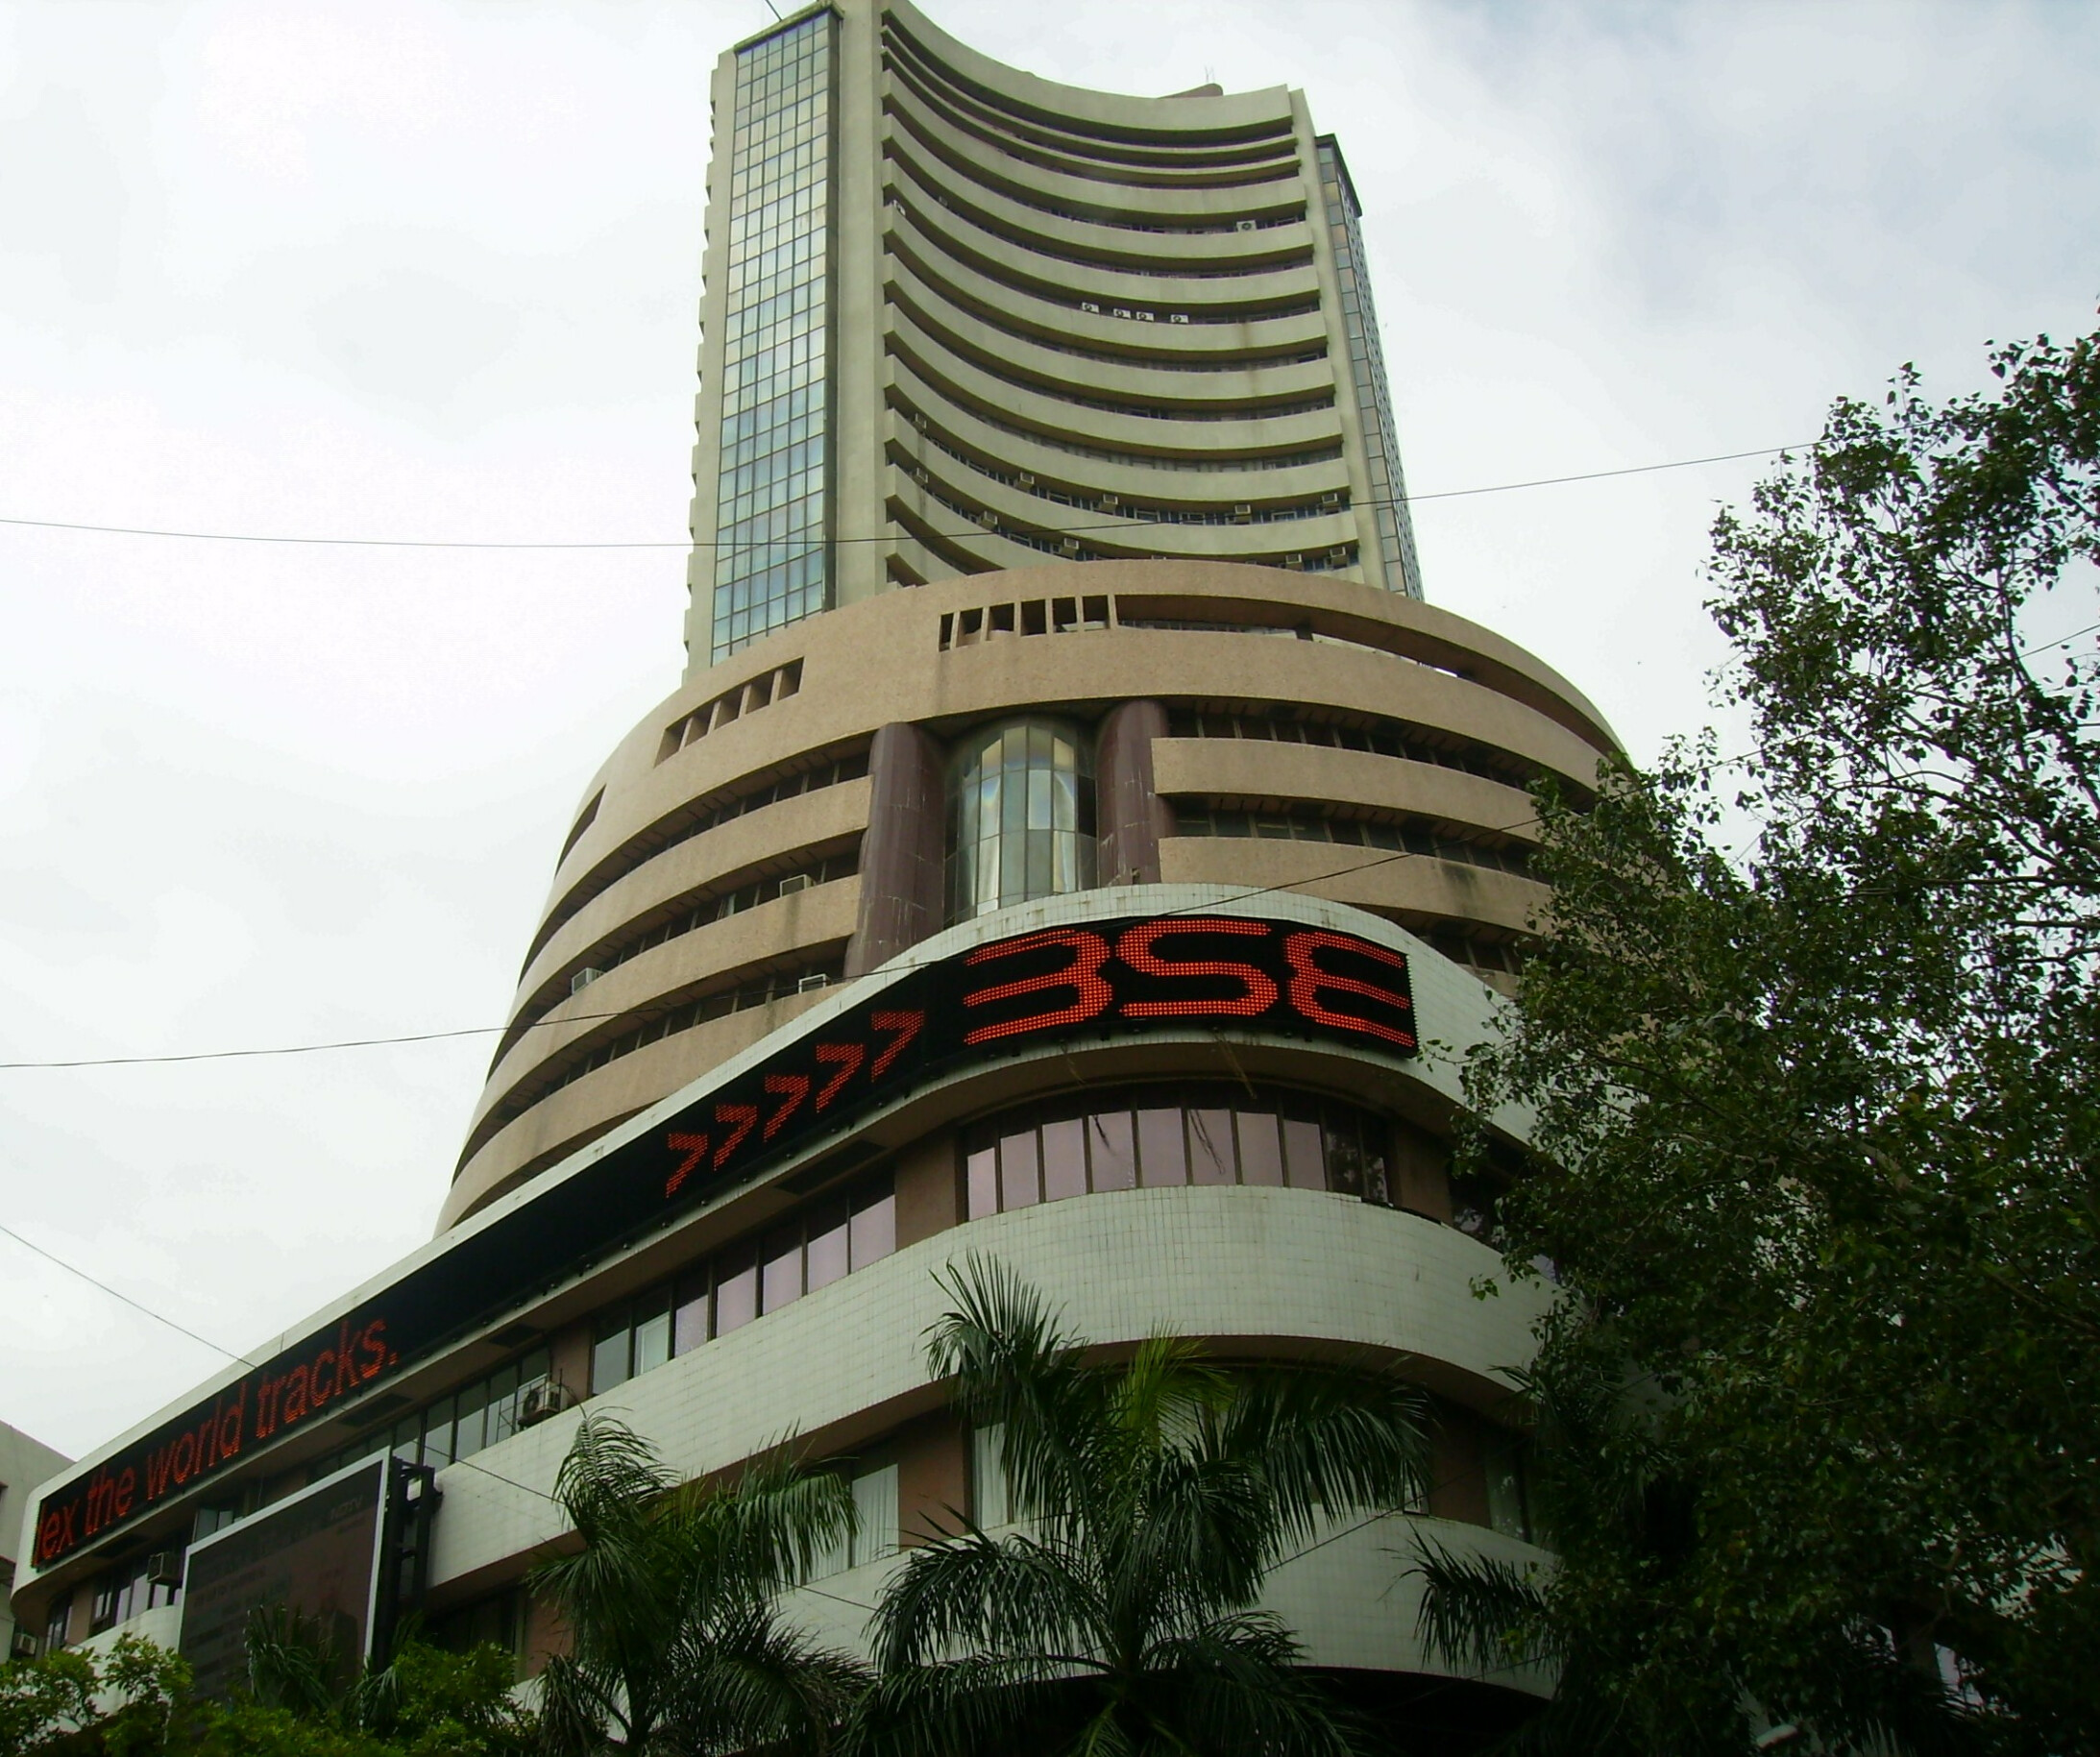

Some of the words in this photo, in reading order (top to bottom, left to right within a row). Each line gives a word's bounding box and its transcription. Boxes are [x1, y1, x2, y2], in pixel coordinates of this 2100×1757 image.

[964, 919, 1416, 1047] BSE
[33, 1499, 80, 1565] ex
[86, 1460, 136, 1536] the
[147, 1384, 247, 1501] world
[255, 1319, 398, 1439] tracks.
